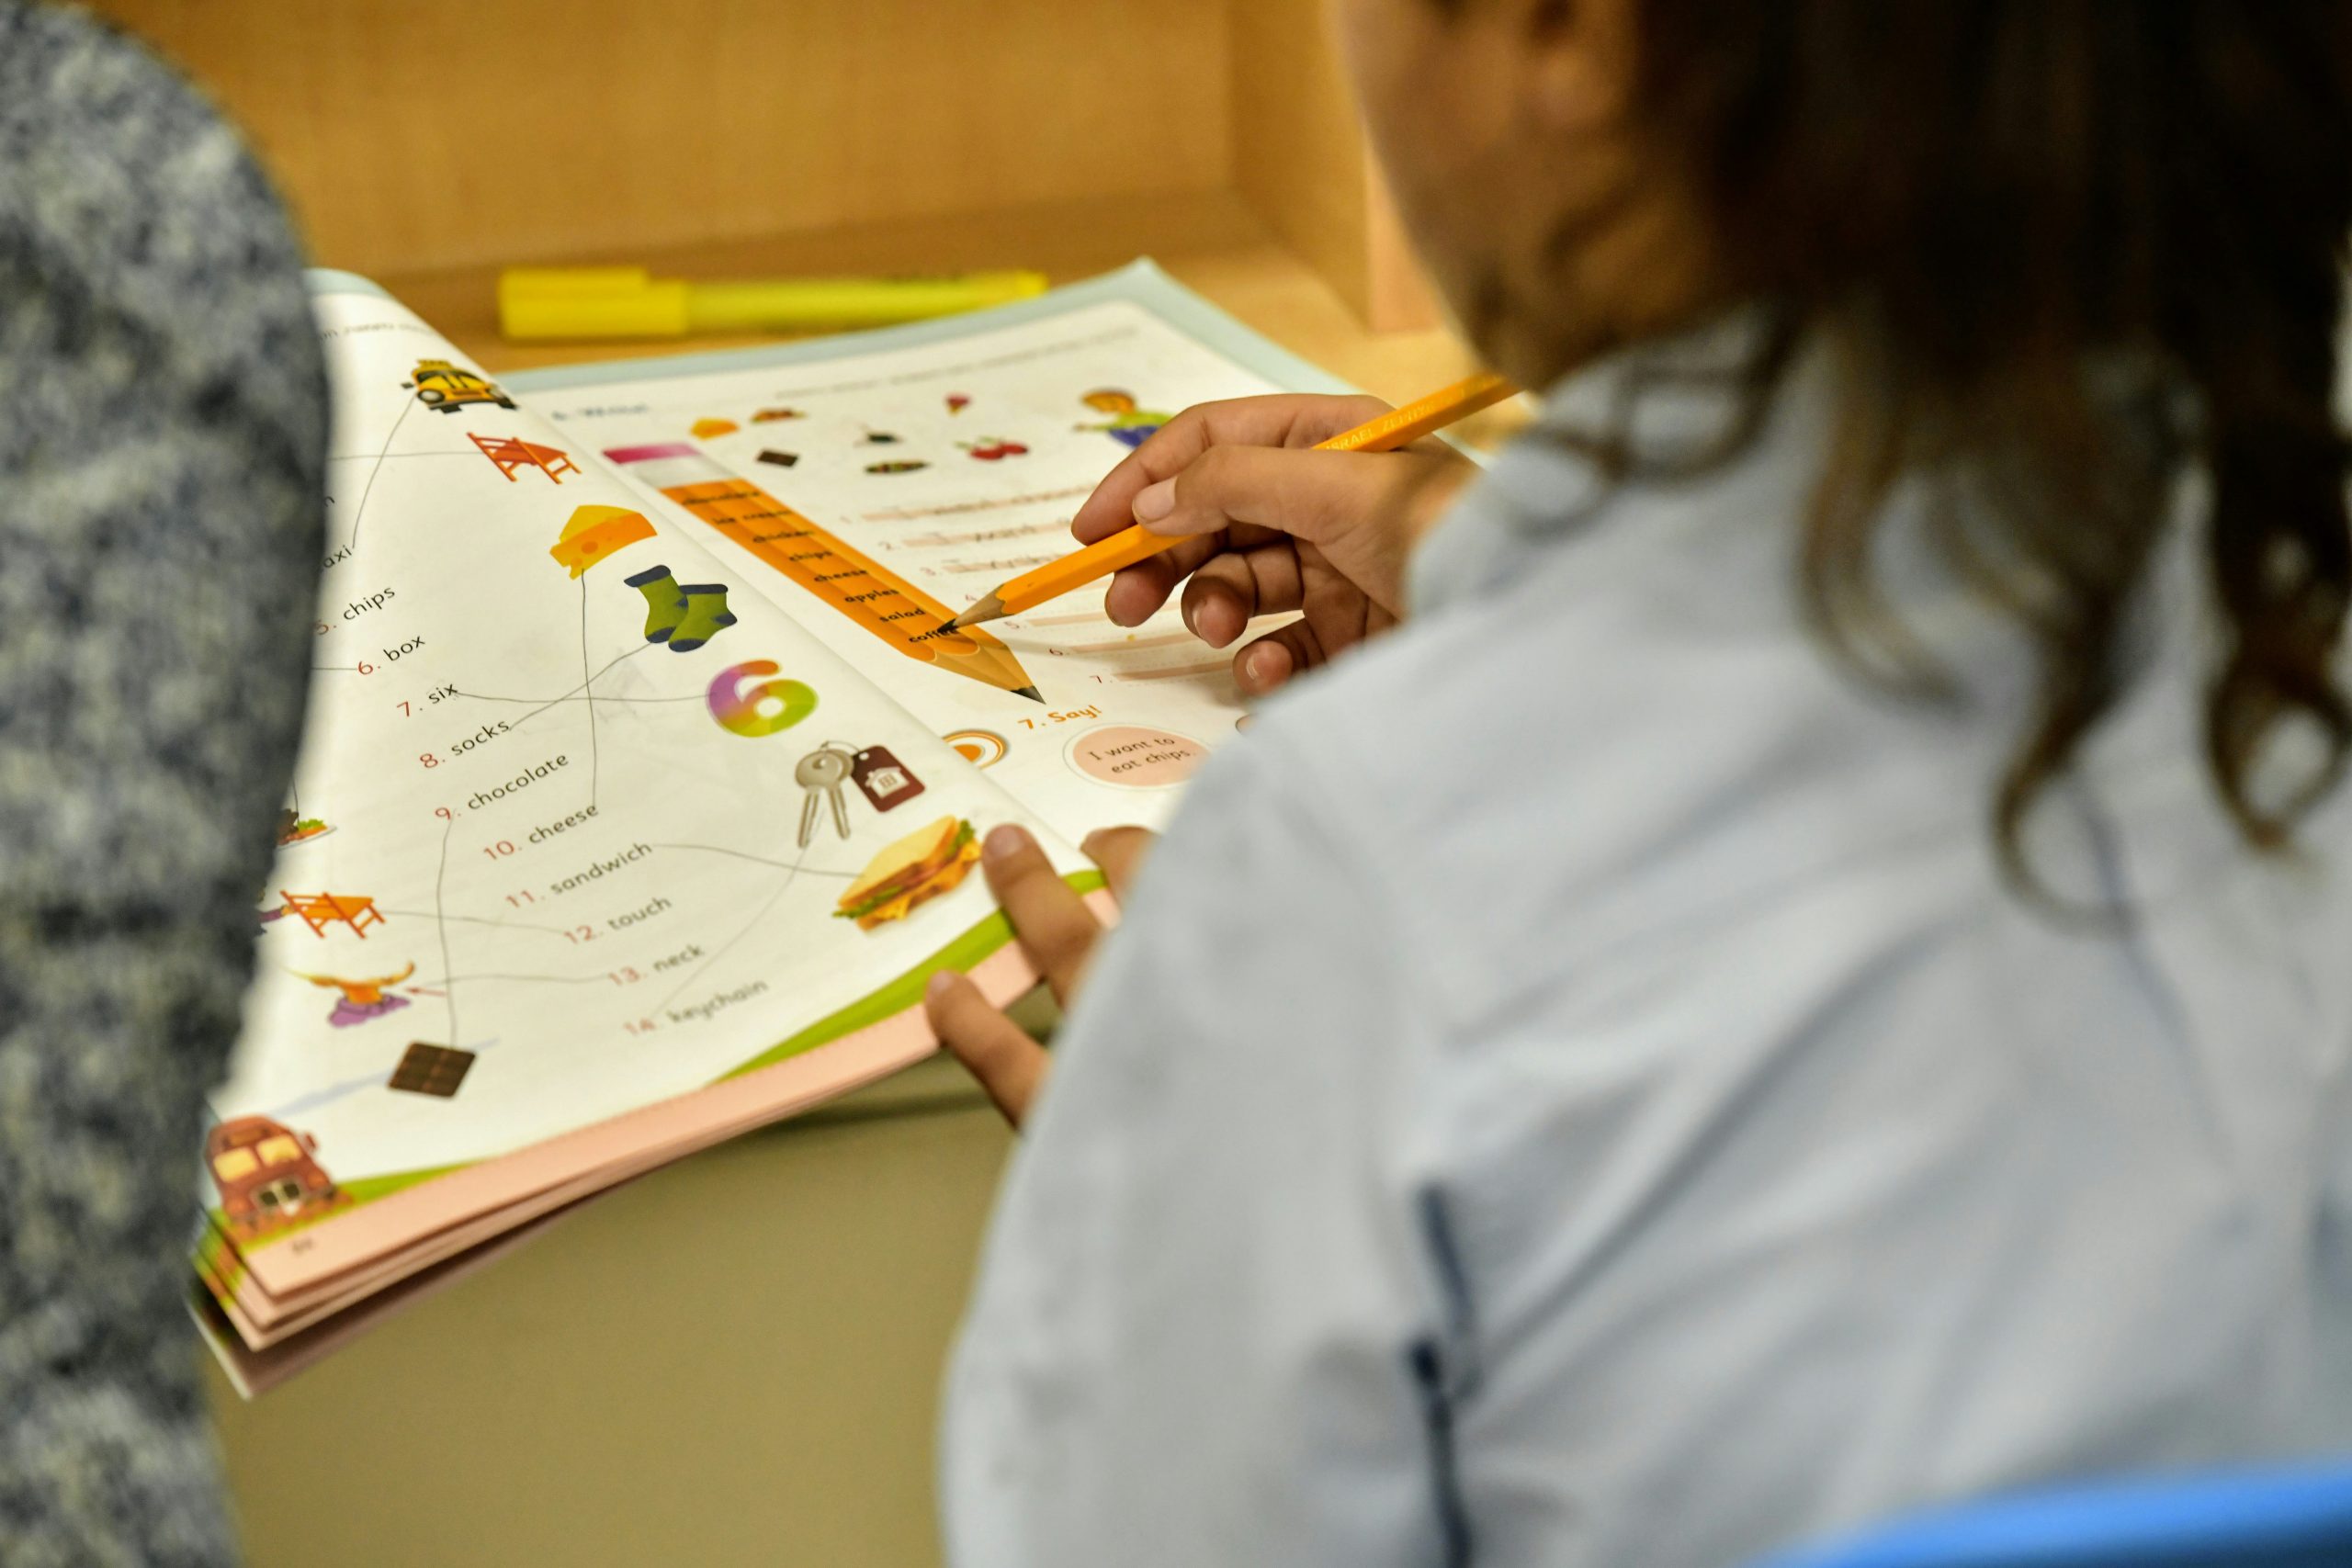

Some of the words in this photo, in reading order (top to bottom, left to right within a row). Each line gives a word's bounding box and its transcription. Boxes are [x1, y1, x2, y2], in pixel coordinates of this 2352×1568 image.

[321, 544, 352, 572] axi
[789, 549, 832, 563] chips
[814, 568, 868, 583] cheese
[343, 587, 395, 621] chips
[844, 588, 900, 604] apples
[878, 606, 927, 624] salad
[357, 660, 382, 675] 6.
[383, 635, 426, 661] box
[396, 700, 424, 717] 7.
[427, 682, 458, 705] six
[1047, 704, 1102, 724] Say!
[419, 752, 447, 769] 8.
[450, 720, 510, 756] socks
[1088, 750, 1103, 762] I
[1104, 739, 1150, 758] want
[1153, 736, 1176, 747] to
[1111, 759, 1142, 774] eat
[434, 807, 462, 821] 9.
[467, 753, 570, 811] chocolate
[482, 840, 523, 861] 10.
[528, 804, 600, 844] cheese
[550, 842, 653, 896] sandwich
[606, 896, 673, 931] touch
[652, 943, 705, 973] neck
[666, 979, 769, 1023] keychain
